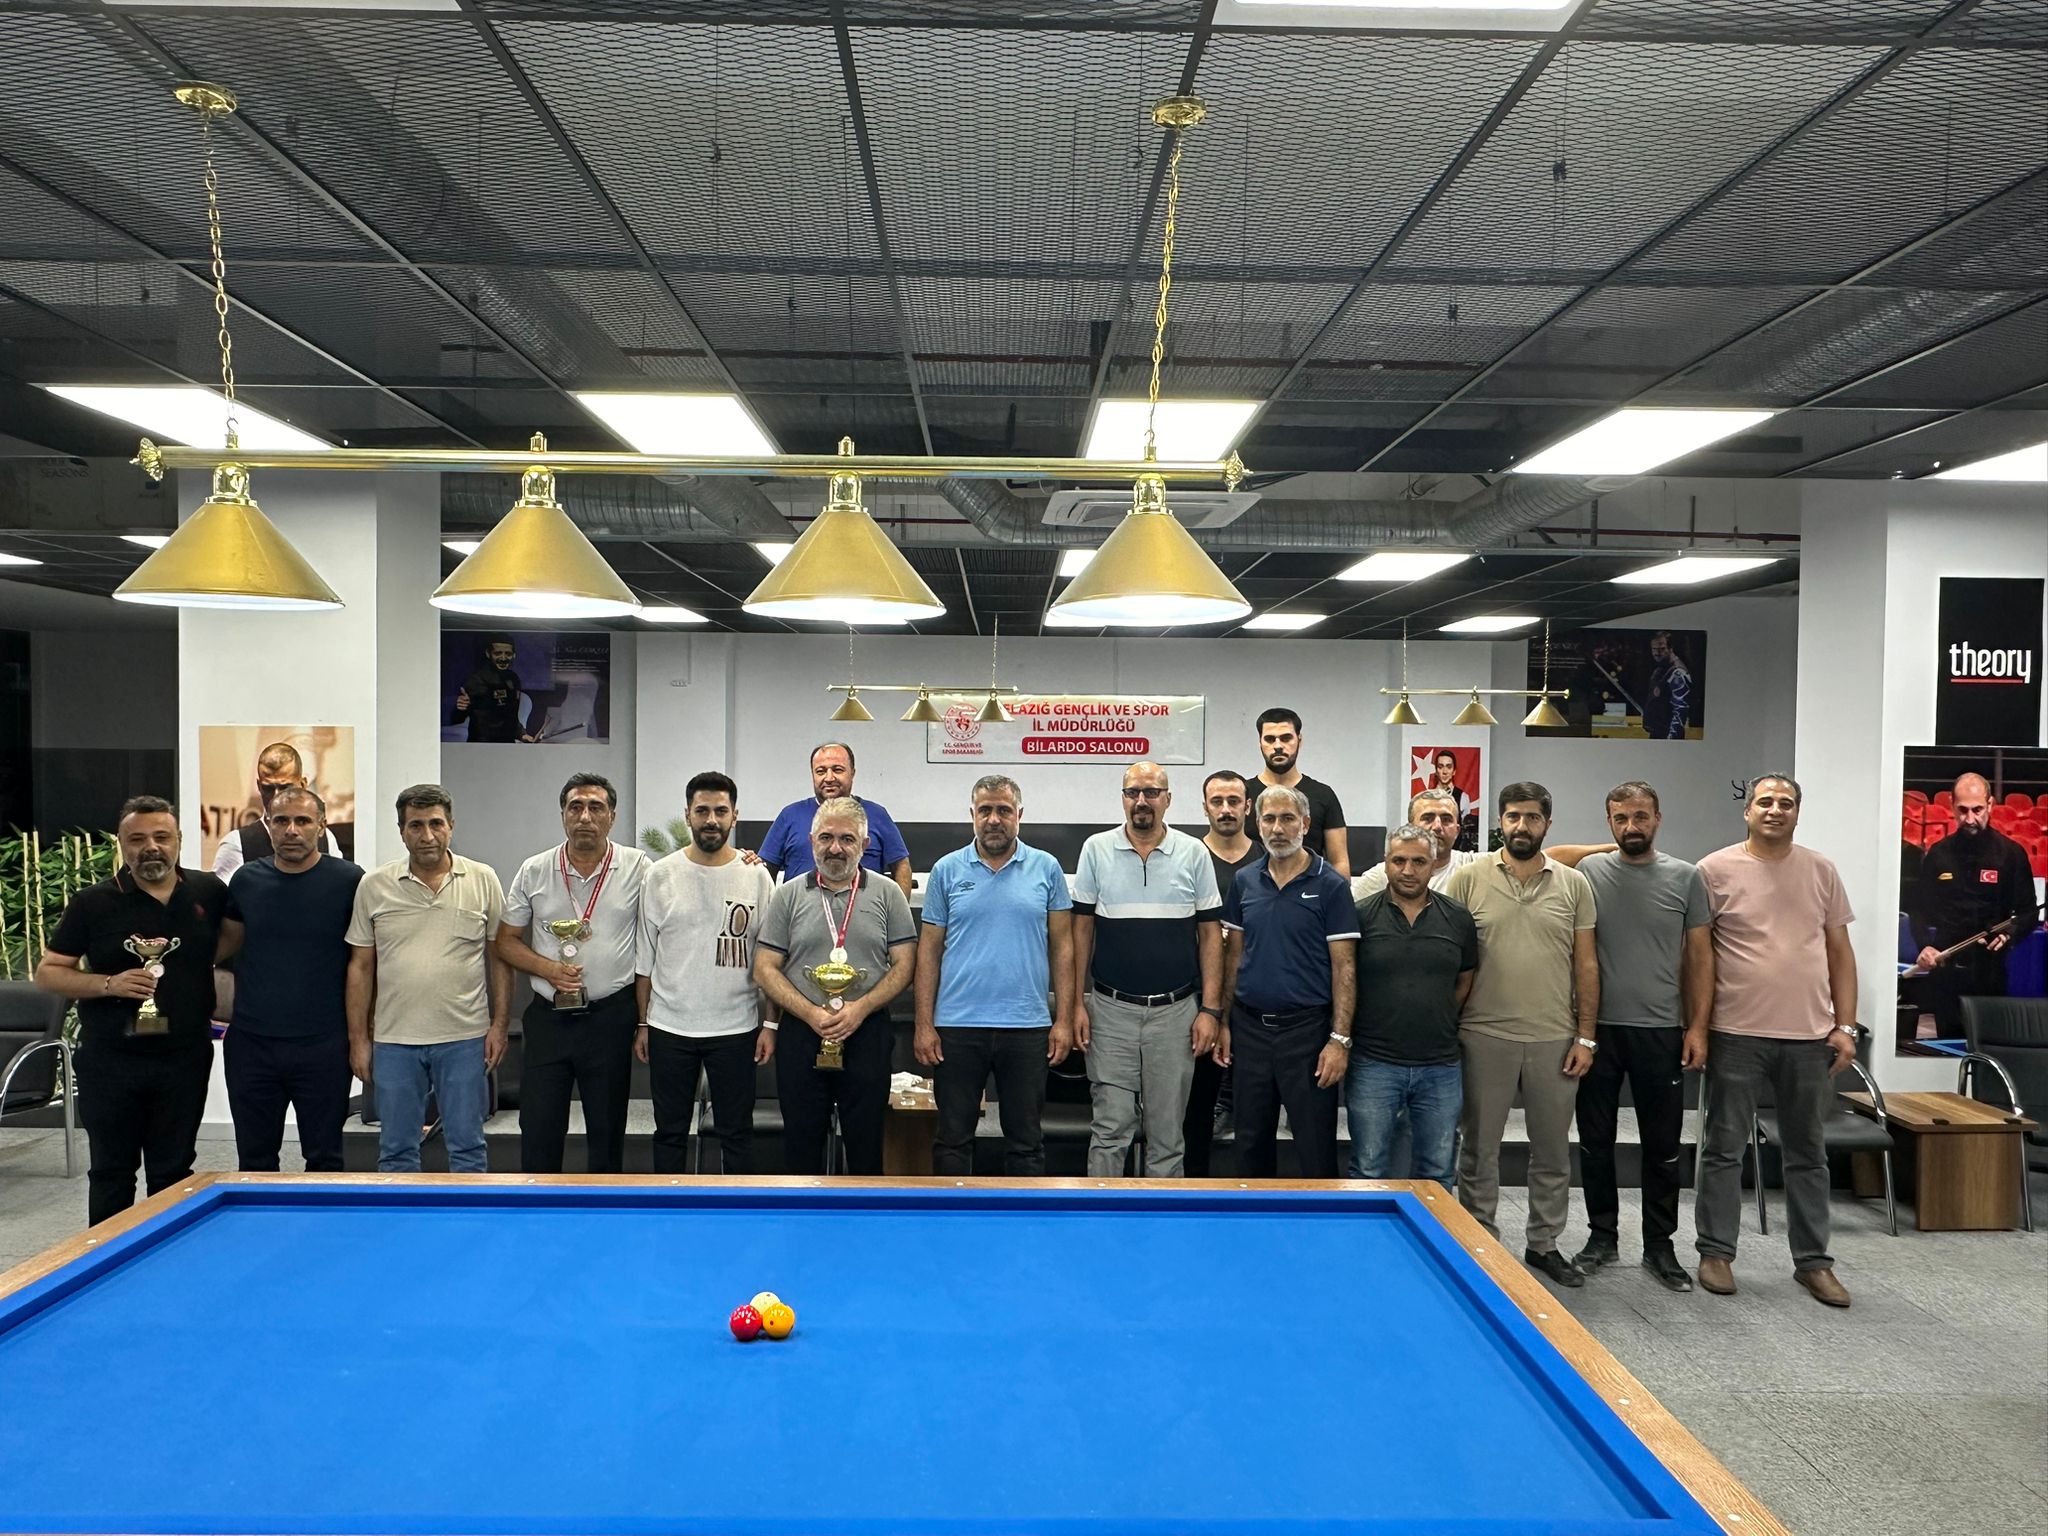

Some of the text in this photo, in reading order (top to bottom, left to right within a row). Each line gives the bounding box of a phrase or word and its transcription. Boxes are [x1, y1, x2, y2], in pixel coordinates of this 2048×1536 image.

[1949, 641, 2031, 684] theory
[1053, 702, 1111, 720] GENÇLİK
[1113, 704, 1131, 716] VE
[1133, 704, 1169, 716] SPOR
[1032, 717, 1136, 732] İL MÜDÜRLÜĞÜ
[1026, 740, 1144, 753] BİLARDO SALONU
